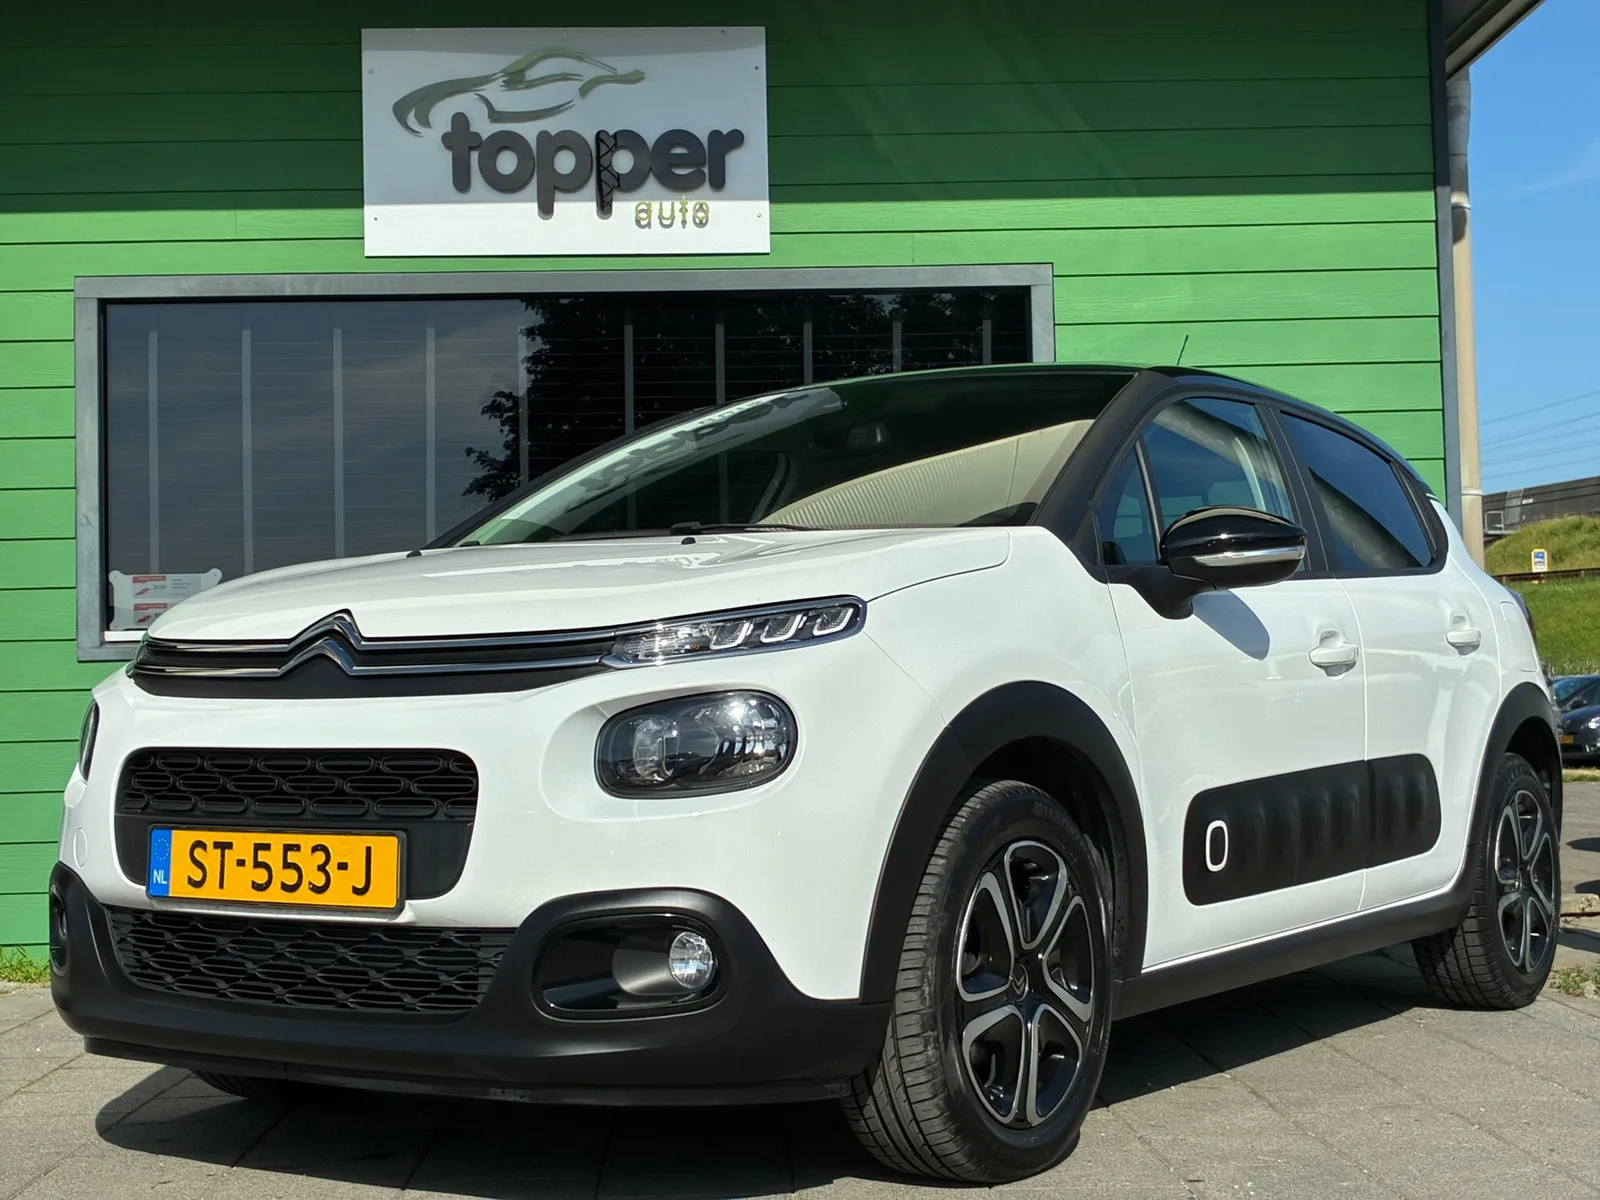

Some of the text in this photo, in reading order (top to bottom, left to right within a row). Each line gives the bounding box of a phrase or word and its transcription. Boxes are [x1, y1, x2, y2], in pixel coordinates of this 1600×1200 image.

[441, 111, 745, 219] topper
[634, 195, 710, 224] auto
[153, 839, 372, 896] NL ST-553-J
